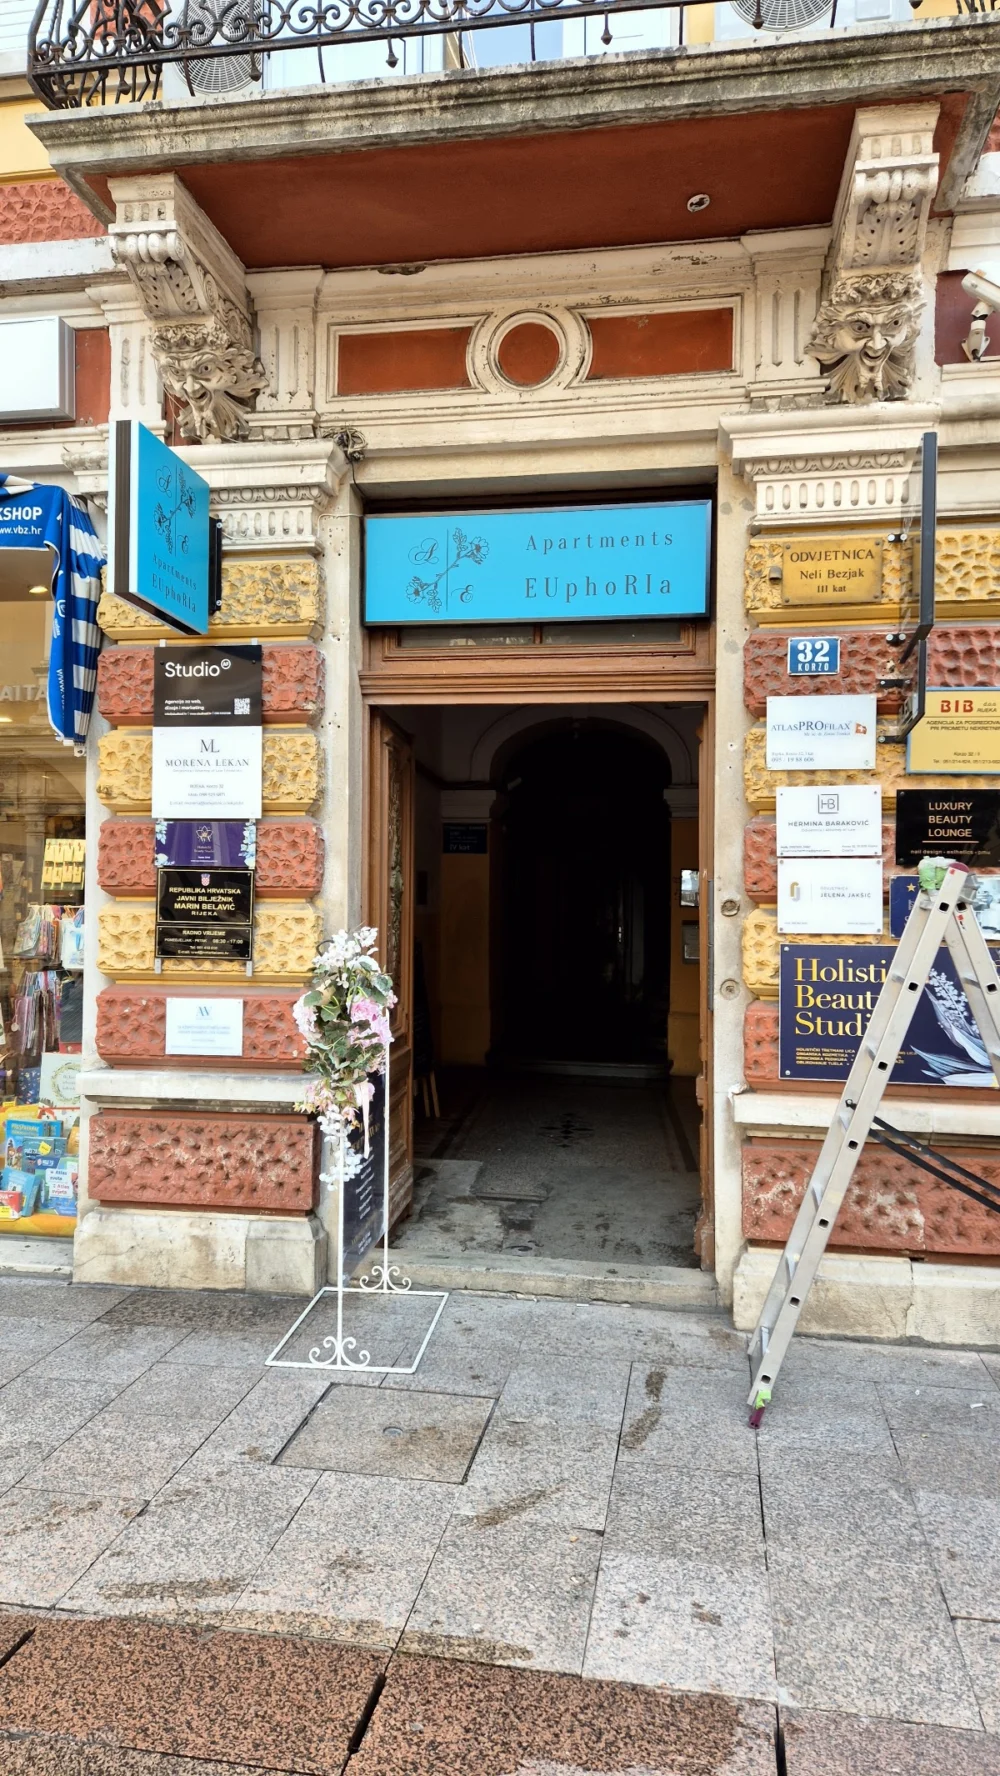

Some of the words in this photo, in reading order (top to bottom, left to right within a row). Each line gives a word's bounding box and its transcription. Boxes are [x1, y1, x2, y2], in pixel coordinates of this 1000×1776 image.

[525, 531, 673, 555] Apartments
[790, 549, 875, 563] ODVJETNICA
[152, 553, 197, 591] Apartments
[800, 569, 822, 580] Neli
[827, 568, 865, 580] Bezjak
[152, 573, 196, 613] EUphoRIa
[524, 573, 672, 603] EUphoRIa
[817, 585, 828, 593] III
[833, 584, 846, 593] kat
[797, 640, 830, 663] 32
[164, 661, 220, 678] Studio
[797, 662, 829, 672] KORZO
[940, 699, 974, 713] BIB
[200, 738, 220, 753] ML
[165, 758, 211, 767] MORENA
[215, 758, 250, 767] LEKAN
[928, 802, 973, 811] LUXURY
[928, 815, 973, 824] BEAUTY
[928, 828, 973, 837] LOUNGE
[174, 902, 200, 910] MARIN
[201, 902, 235, 911] BELAVIĆ
[794, 957, 888, 983] Holisti
[794, 984, 880, 1010] Beaut
[795, 1011, 872, 1037] Studi
